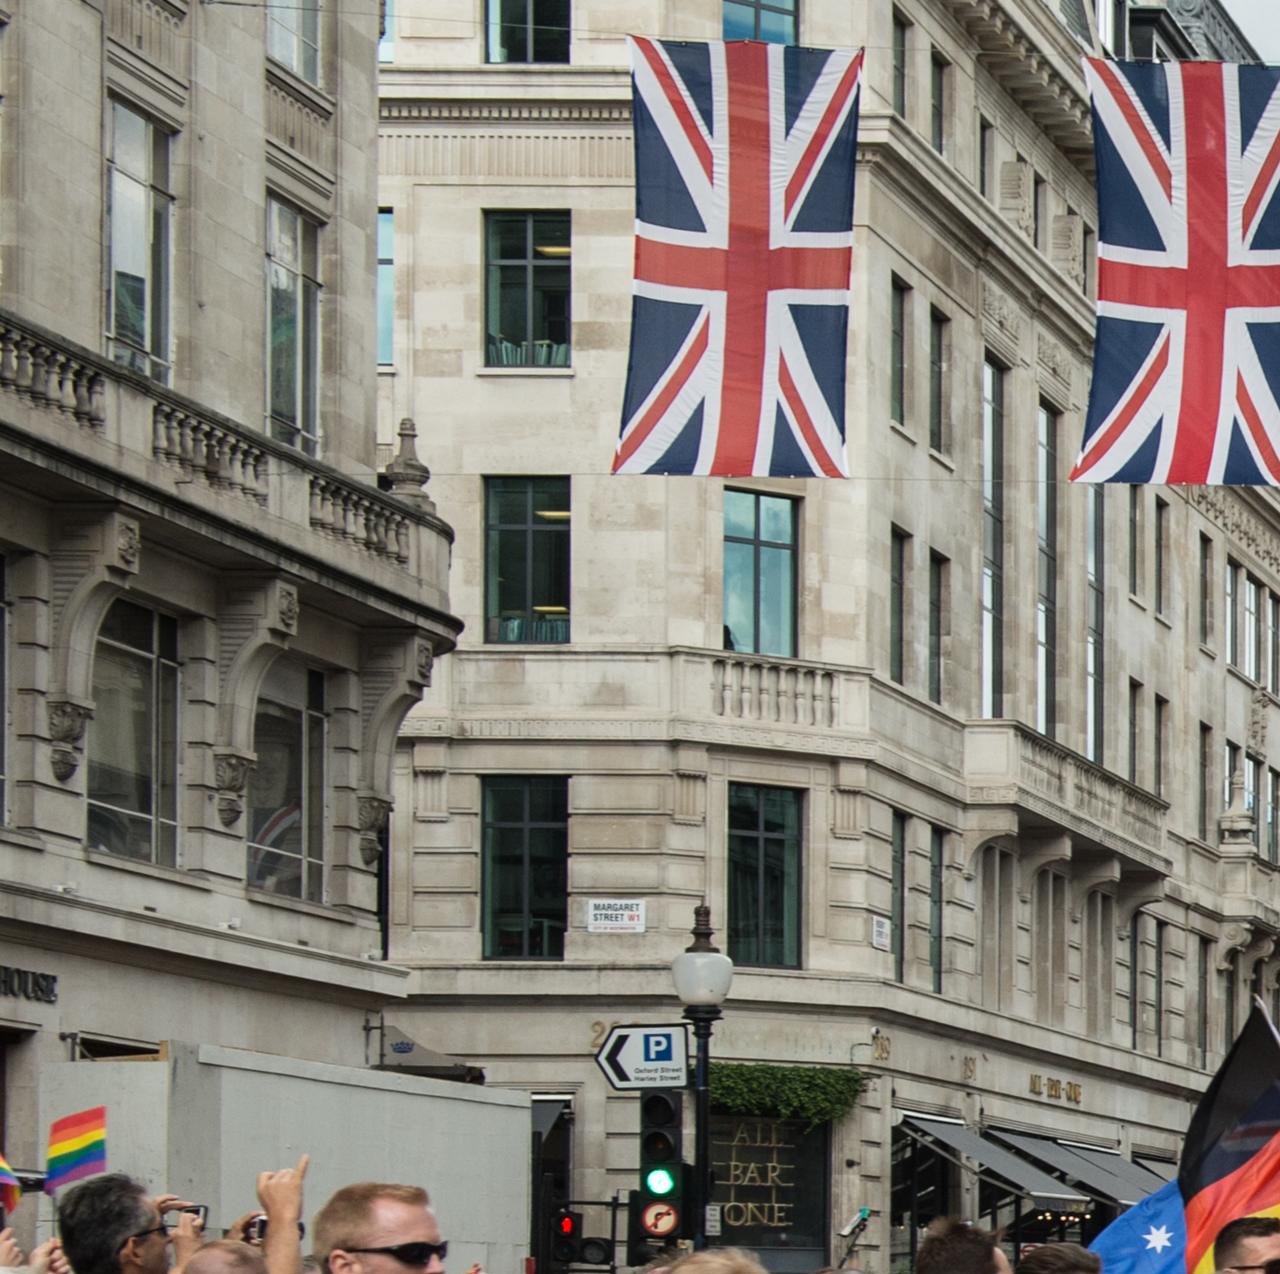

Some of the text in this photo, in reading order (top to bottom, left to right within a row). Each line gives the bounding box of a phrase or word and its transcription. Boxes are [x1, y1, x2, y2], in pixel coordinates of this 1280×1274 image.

[593, 903, 640, 911] MARGARET
[593, 913, 624, 922] STREET
[649, 1036, 668, 1059] P
[732, 1122, 784, 1147] ALL
[729, 1162, 784, 1186] BAR
[724, 1202, 787, 1226] ONE
